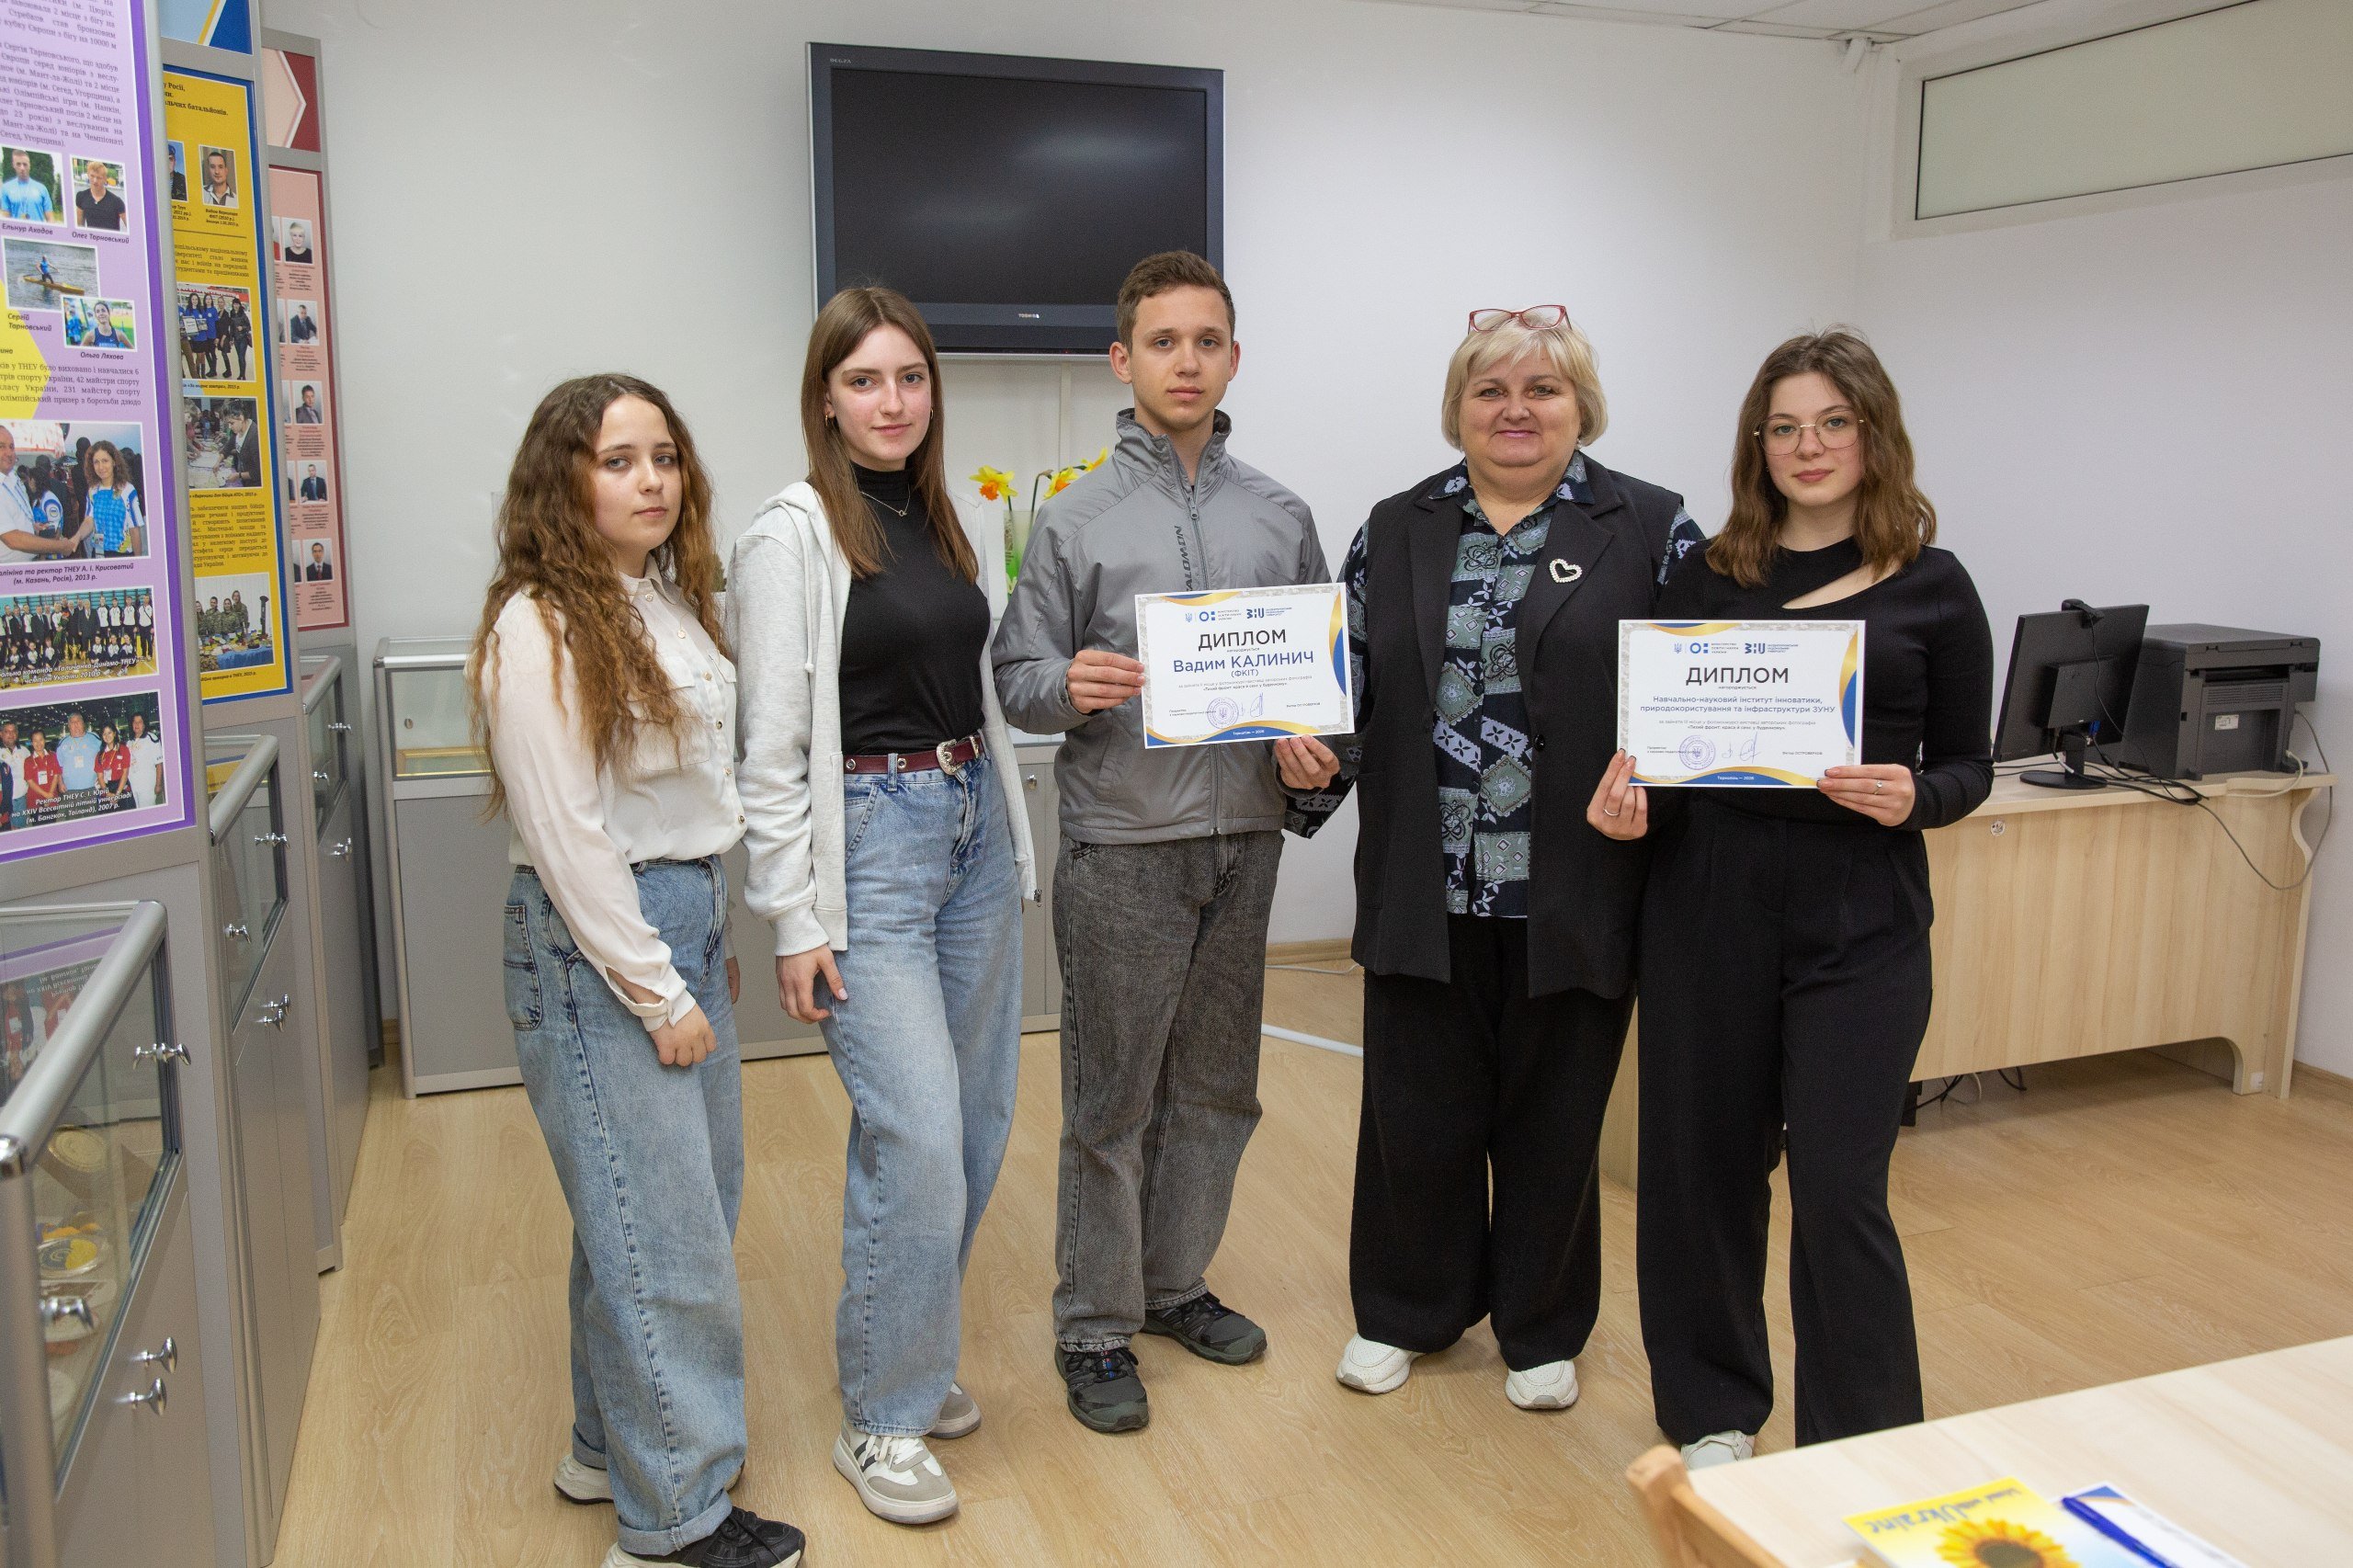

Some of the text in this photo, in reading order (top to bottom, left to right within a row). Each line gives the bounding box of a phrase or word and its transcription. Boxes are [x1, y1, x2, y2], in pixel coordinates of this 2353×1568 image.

[90, 6, 114, 18] Цюріх,
[77, 24, 116, 39] бронзовим
[96, 62, 118, 72] здобув
[169, 83, 186, 92] Росії,
[16, 99, 64, 114] Тарновський
[95, 103, 121, 114] Нанкін,
[188, 104, 228, 116] батальйонів.
[28, 114, 51, 123] років)
[85, 133, 123, 147] Чемпіонаті
[2, 222, 27, 232] Ельнур
[89, 233, 129, 244] Тарновський
[7, 312, 29, 322] Сергій
[9, 322, 51, 332] Тарновський
[81, 351, 99, 360] Ольга
[44, 375, 74, 384] України,
[86, 377, 116, 386] майстри
[26, 384, 59, 393] України,
[37, 567, 63, 577] ректор
[96, 562, 134, 572] Крисоватий
[26, 575, 51, 585] Казань,
[52, 574, 74, 583] Росія),
[1199, 630, 1287, 652] ДИПЛОМ
[1173, 651, 1314, 674] Вадим КАЛИНИЧ
[23, 667, 52, 676] команда
[1231, 669, 1259, 678] (ФКІТ)
[1686, 667, 1789, 686] ДИПЛОМ
[53, 673, 79, 682] України
[35, 796, 61, 806] Ректор
[63, 792, 79, 801] ТНЕУ
[81, 791, 86, 800] С.
[93, 788, 108, 798] Юрій
[39, 801, 74, 814] Всесвітній
[75, 798, 97, 807] літній
[98, 792, 132, 805] універсіаді
[38, 811, 66, 823] Бангкок,
[68, 807, 97, 818] Таїланд),
[97, 804, 112, 812] 2007
